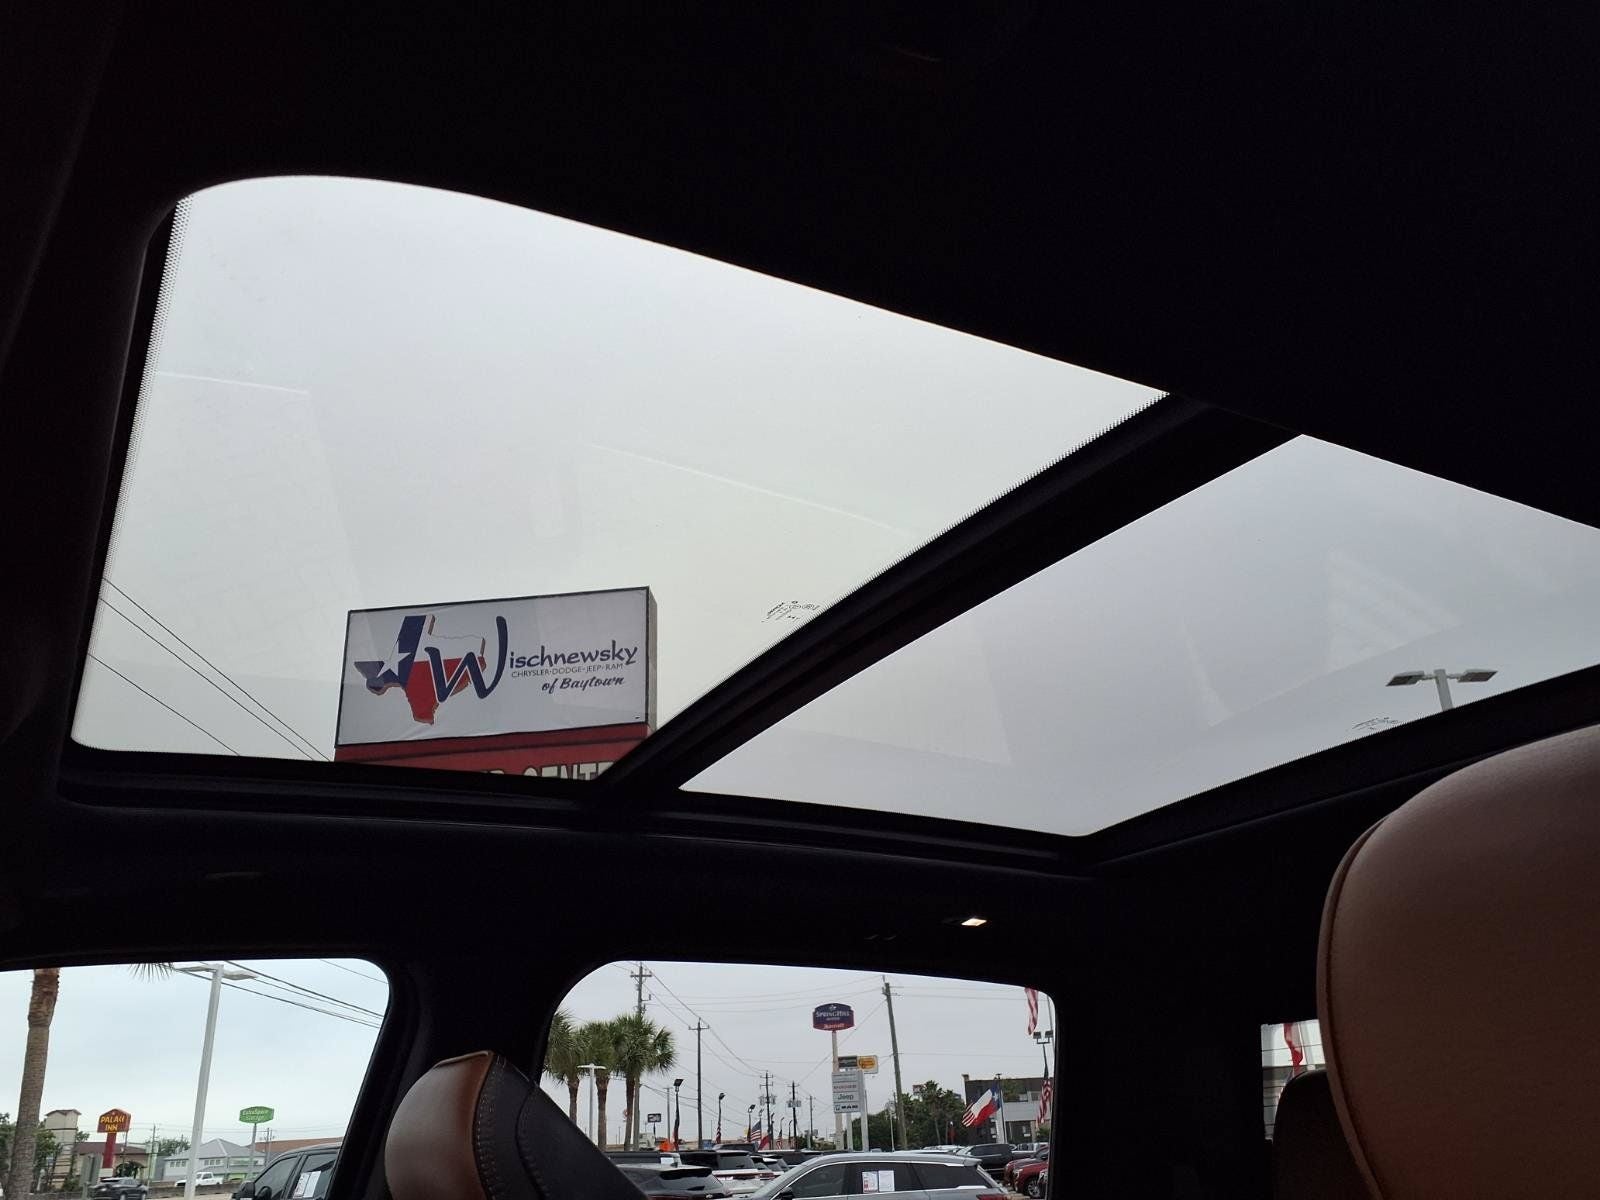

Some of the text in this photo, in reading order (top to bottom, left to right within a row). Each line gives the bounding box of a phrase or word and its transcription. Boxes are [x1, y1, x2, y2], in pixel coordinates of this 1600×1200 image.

[511, 663, 623, 678] CHRYSLER DODGE JEEP RAM
[541, 676, 625, 694] of Baytown
